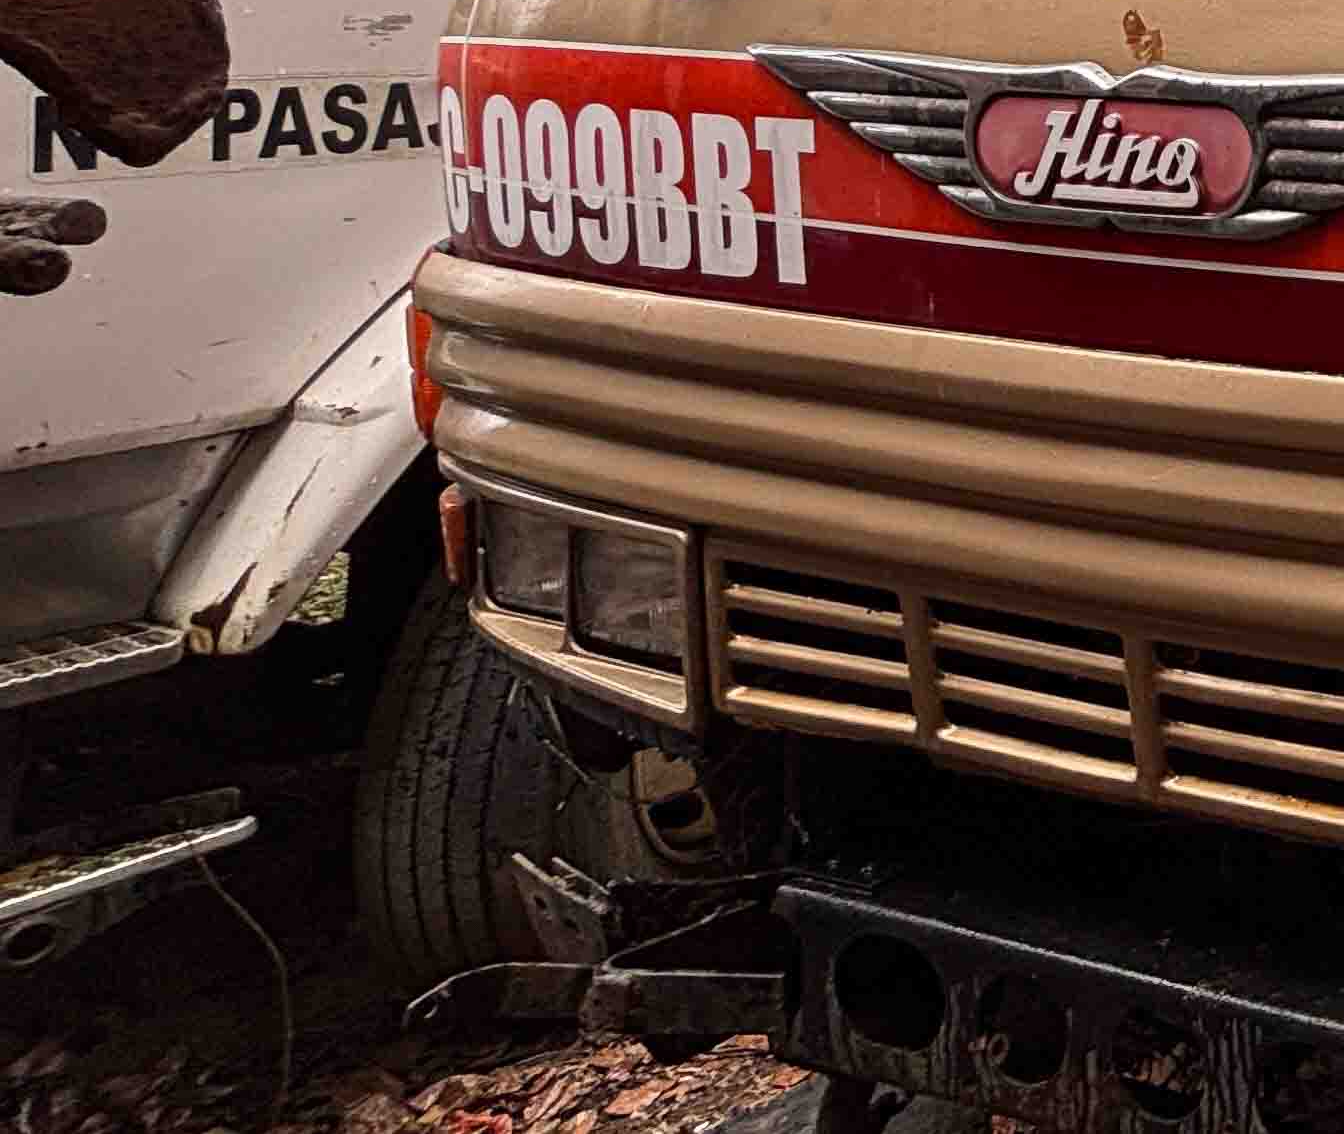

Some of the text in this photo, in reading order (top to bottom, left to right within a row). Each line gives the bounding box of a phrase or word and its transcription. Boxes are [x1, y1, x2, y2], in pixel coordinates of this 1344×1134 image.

[211, 82, 442, 163] PASA
[1014, 98, 1200, 208] Hino
[440, 85, 816, 285] C-099BBT
